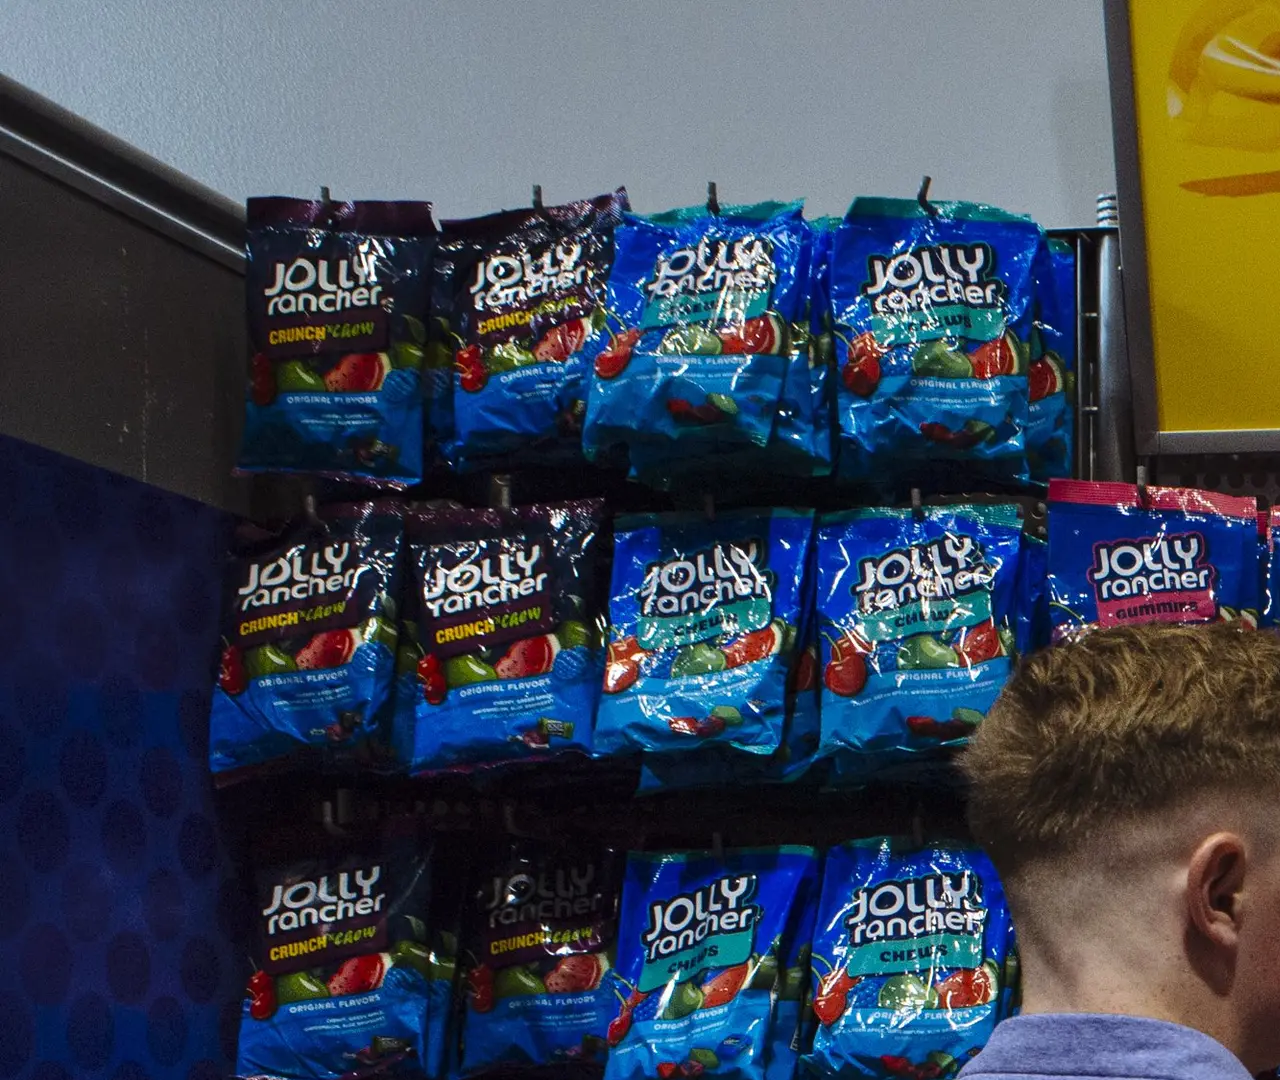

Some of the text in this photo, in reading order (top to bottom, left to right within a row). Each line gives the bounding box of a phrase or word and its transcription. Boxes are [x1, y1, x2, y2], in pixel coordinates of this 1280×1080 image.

[264, 250, 376, 296] JOLLY
[268, 285, 383, 316] rancher
[269, 326, 326, 345] CRUNCH
[1094, 538, 1198, 580] JOLLY
[1101, 568, 1209, 599] rancher
[263, 866, 380, 916] JOLLY
[849, 870, 970, 924] JOLLY
[268, 893, 386, 935] rancher
[854, 909, 984, 943] rancher
[269, 935, 327, 961] CRUNCH
[879, 945, 948, 963] CHEWS
